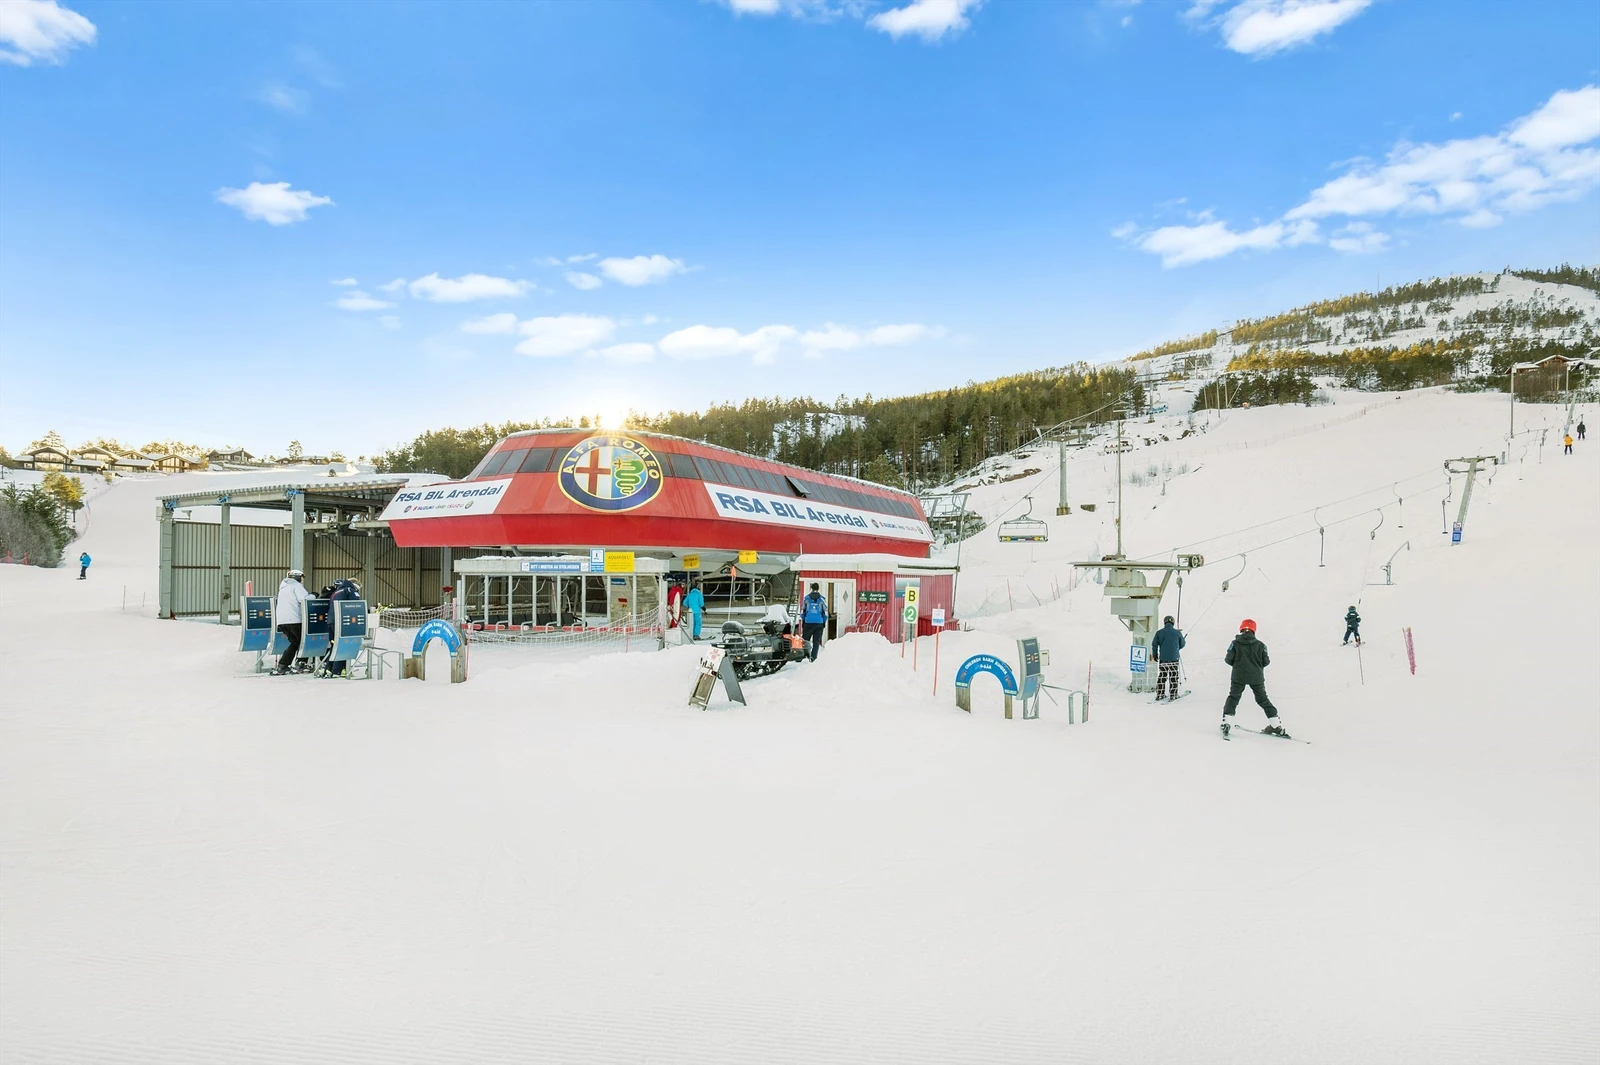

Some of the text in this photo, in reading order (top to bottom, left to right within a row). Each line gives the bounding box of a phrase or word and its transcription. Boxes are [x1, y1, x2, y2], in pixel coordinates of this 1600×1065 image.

[563, 437, 660, 479] ALFA ROMEO
[395, 485, 504, 502] RSA BIL Arendal
[715, 492, 868, 528] RSA BIL Arendal
[908, 590, 916, 602] B
[906, 608, 915, 620] 2
